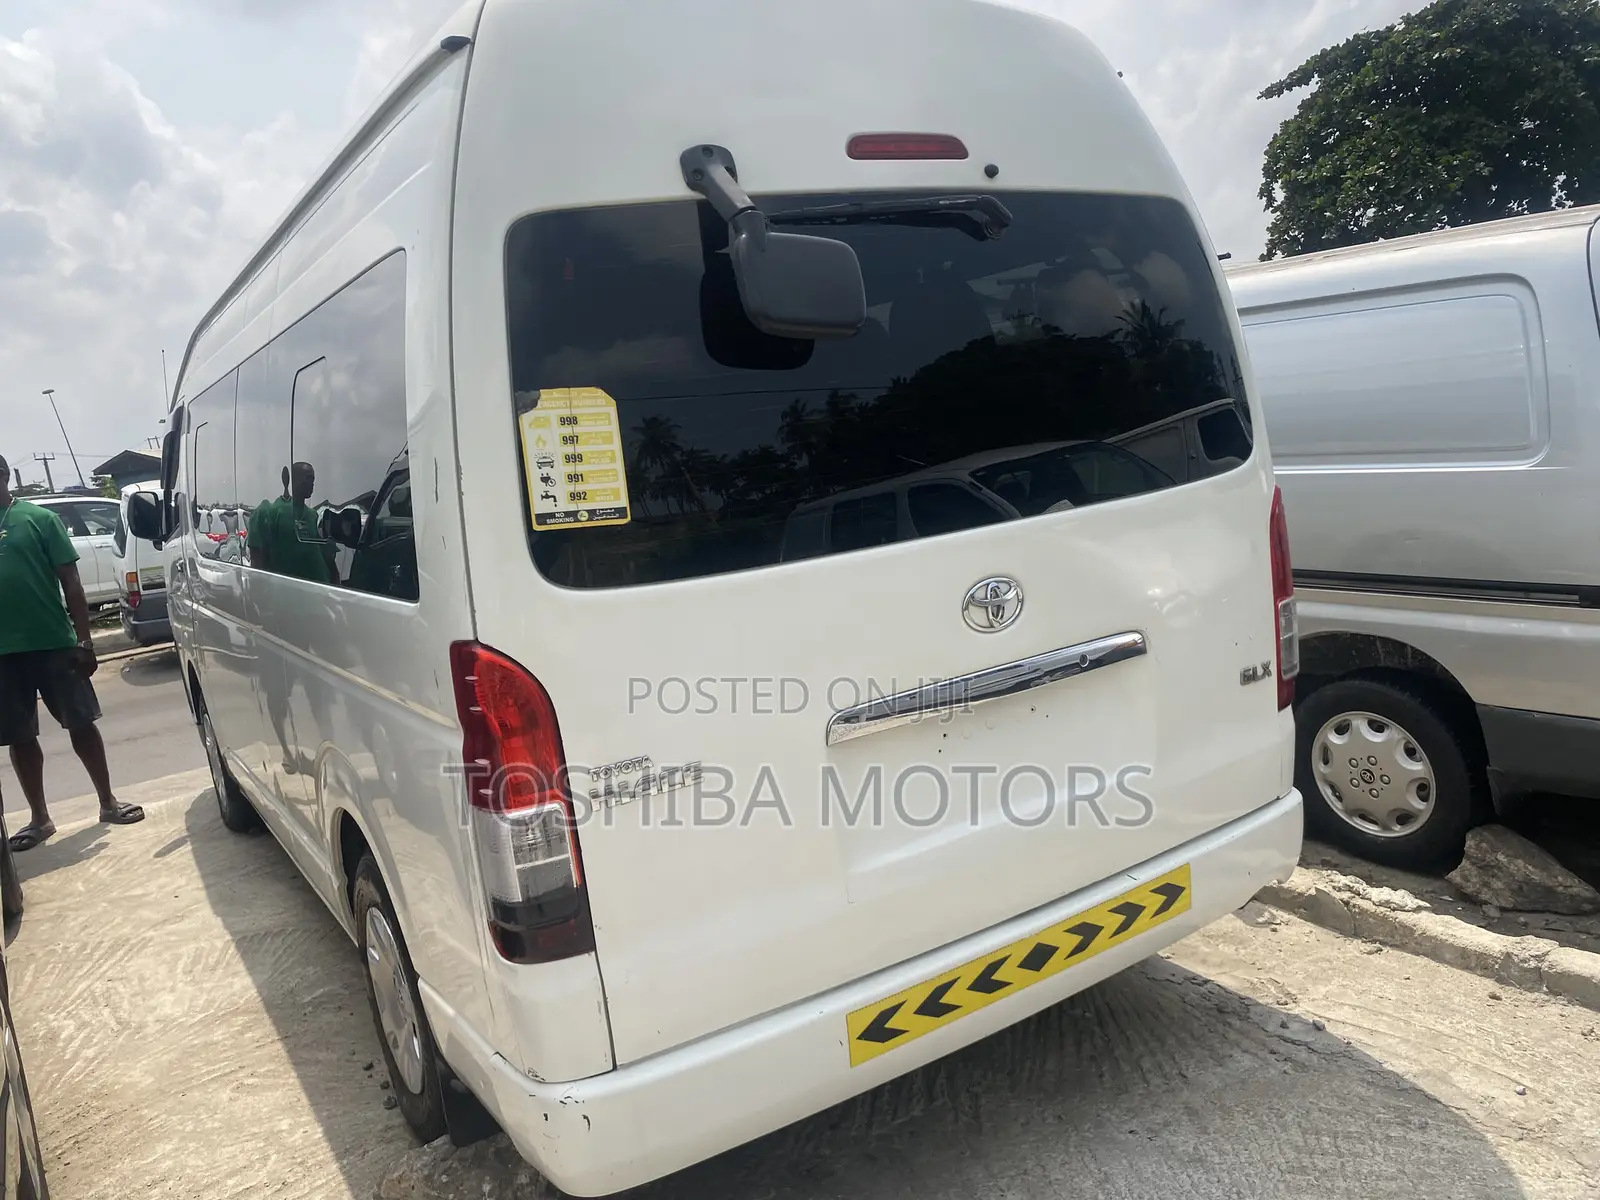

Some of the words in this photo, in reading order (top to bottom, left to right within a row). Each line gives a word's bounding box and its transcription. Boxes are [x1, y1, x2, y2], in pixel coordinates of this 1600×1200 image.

[559, 416, 578, 426] 998
[562, 435, 579, 445] 997
[564, 453, 583, 463] 999
[567, 473, 584, 483] 991
[569, 491, 587, 501] 992
[546, 516, 574, 524] SMOKING
[1240, 660, 1272, 686] GLX
[588, 755, 654, 782] TOYOTA
[589, 760, 705, 812] HIACE
